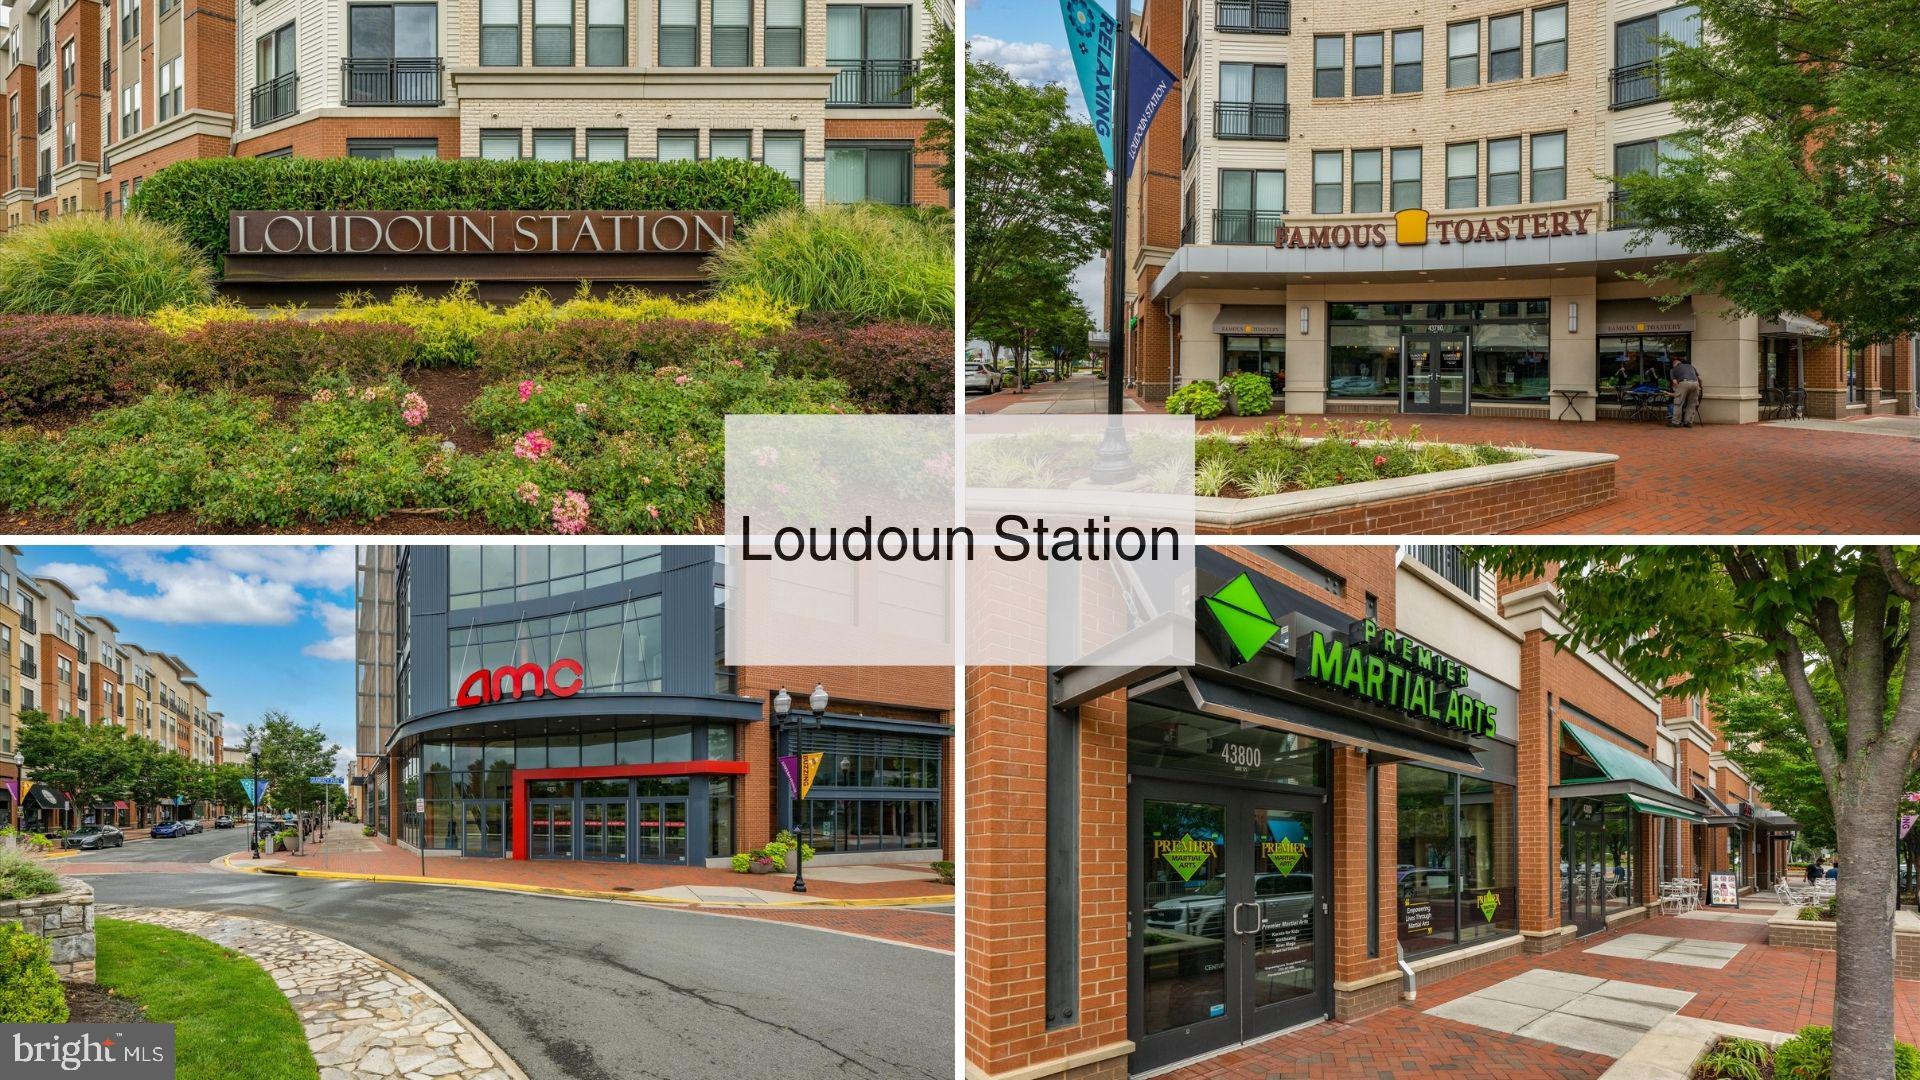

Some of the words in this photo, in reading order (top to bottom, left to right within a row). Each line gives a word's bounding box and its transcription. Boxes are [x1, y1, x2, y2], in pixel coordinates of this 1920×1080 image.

[1096, 13, 1115, 138] RELAXING
[1129, 114, 1149, 160] LOUDOUN
[1146, 80, 1168, 119] STATION
[237, 214, 497, 253] LOUDOUN
[514, 214, 729, 252] STATION
[1273, 223, 1387, 248] FAMOUS
[1435, 208, 1593, 244] TOASTERY
[1364, 618, 1469, 688] PREMIER
[1310, 630, 1441, 720] MARTIAL
[1444, 688, 1498, 737] ARTS
[1221, 743, 1261, 767] 43800
[1153, 840, 1218, 859] PREMIER
[1261, 842, 1308, 859] PREMIER
[1281, 920, 1299, 928] Martial
